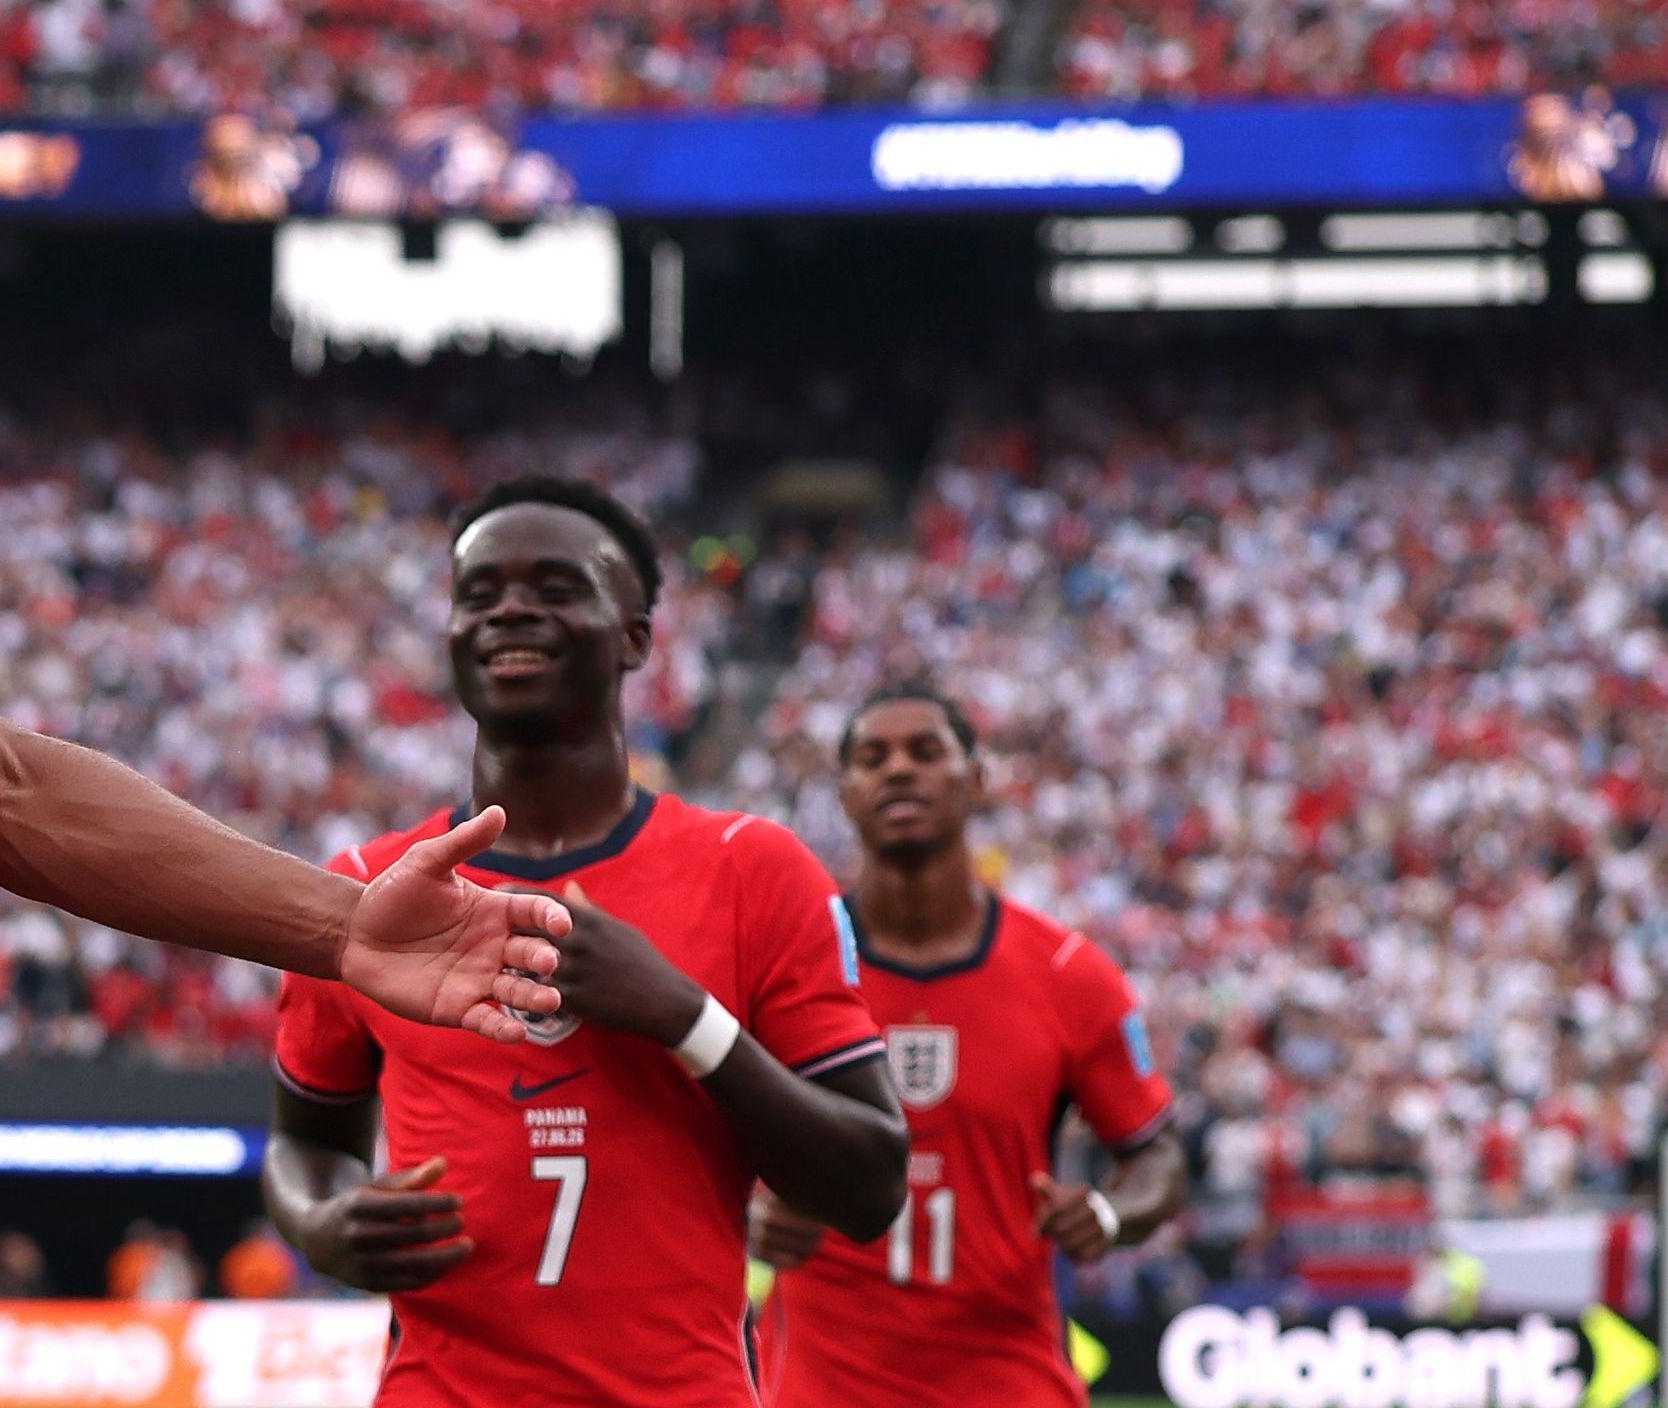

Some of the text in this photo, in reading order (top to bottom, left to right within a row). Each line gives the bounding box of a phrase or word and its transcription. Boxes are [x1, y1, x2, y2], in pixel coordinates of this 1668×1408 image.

[525, 1107, 587, 1127] PANAMA
[531, 1155, 587, 1287] 7
[889, 1188, 955, 1285] 11
